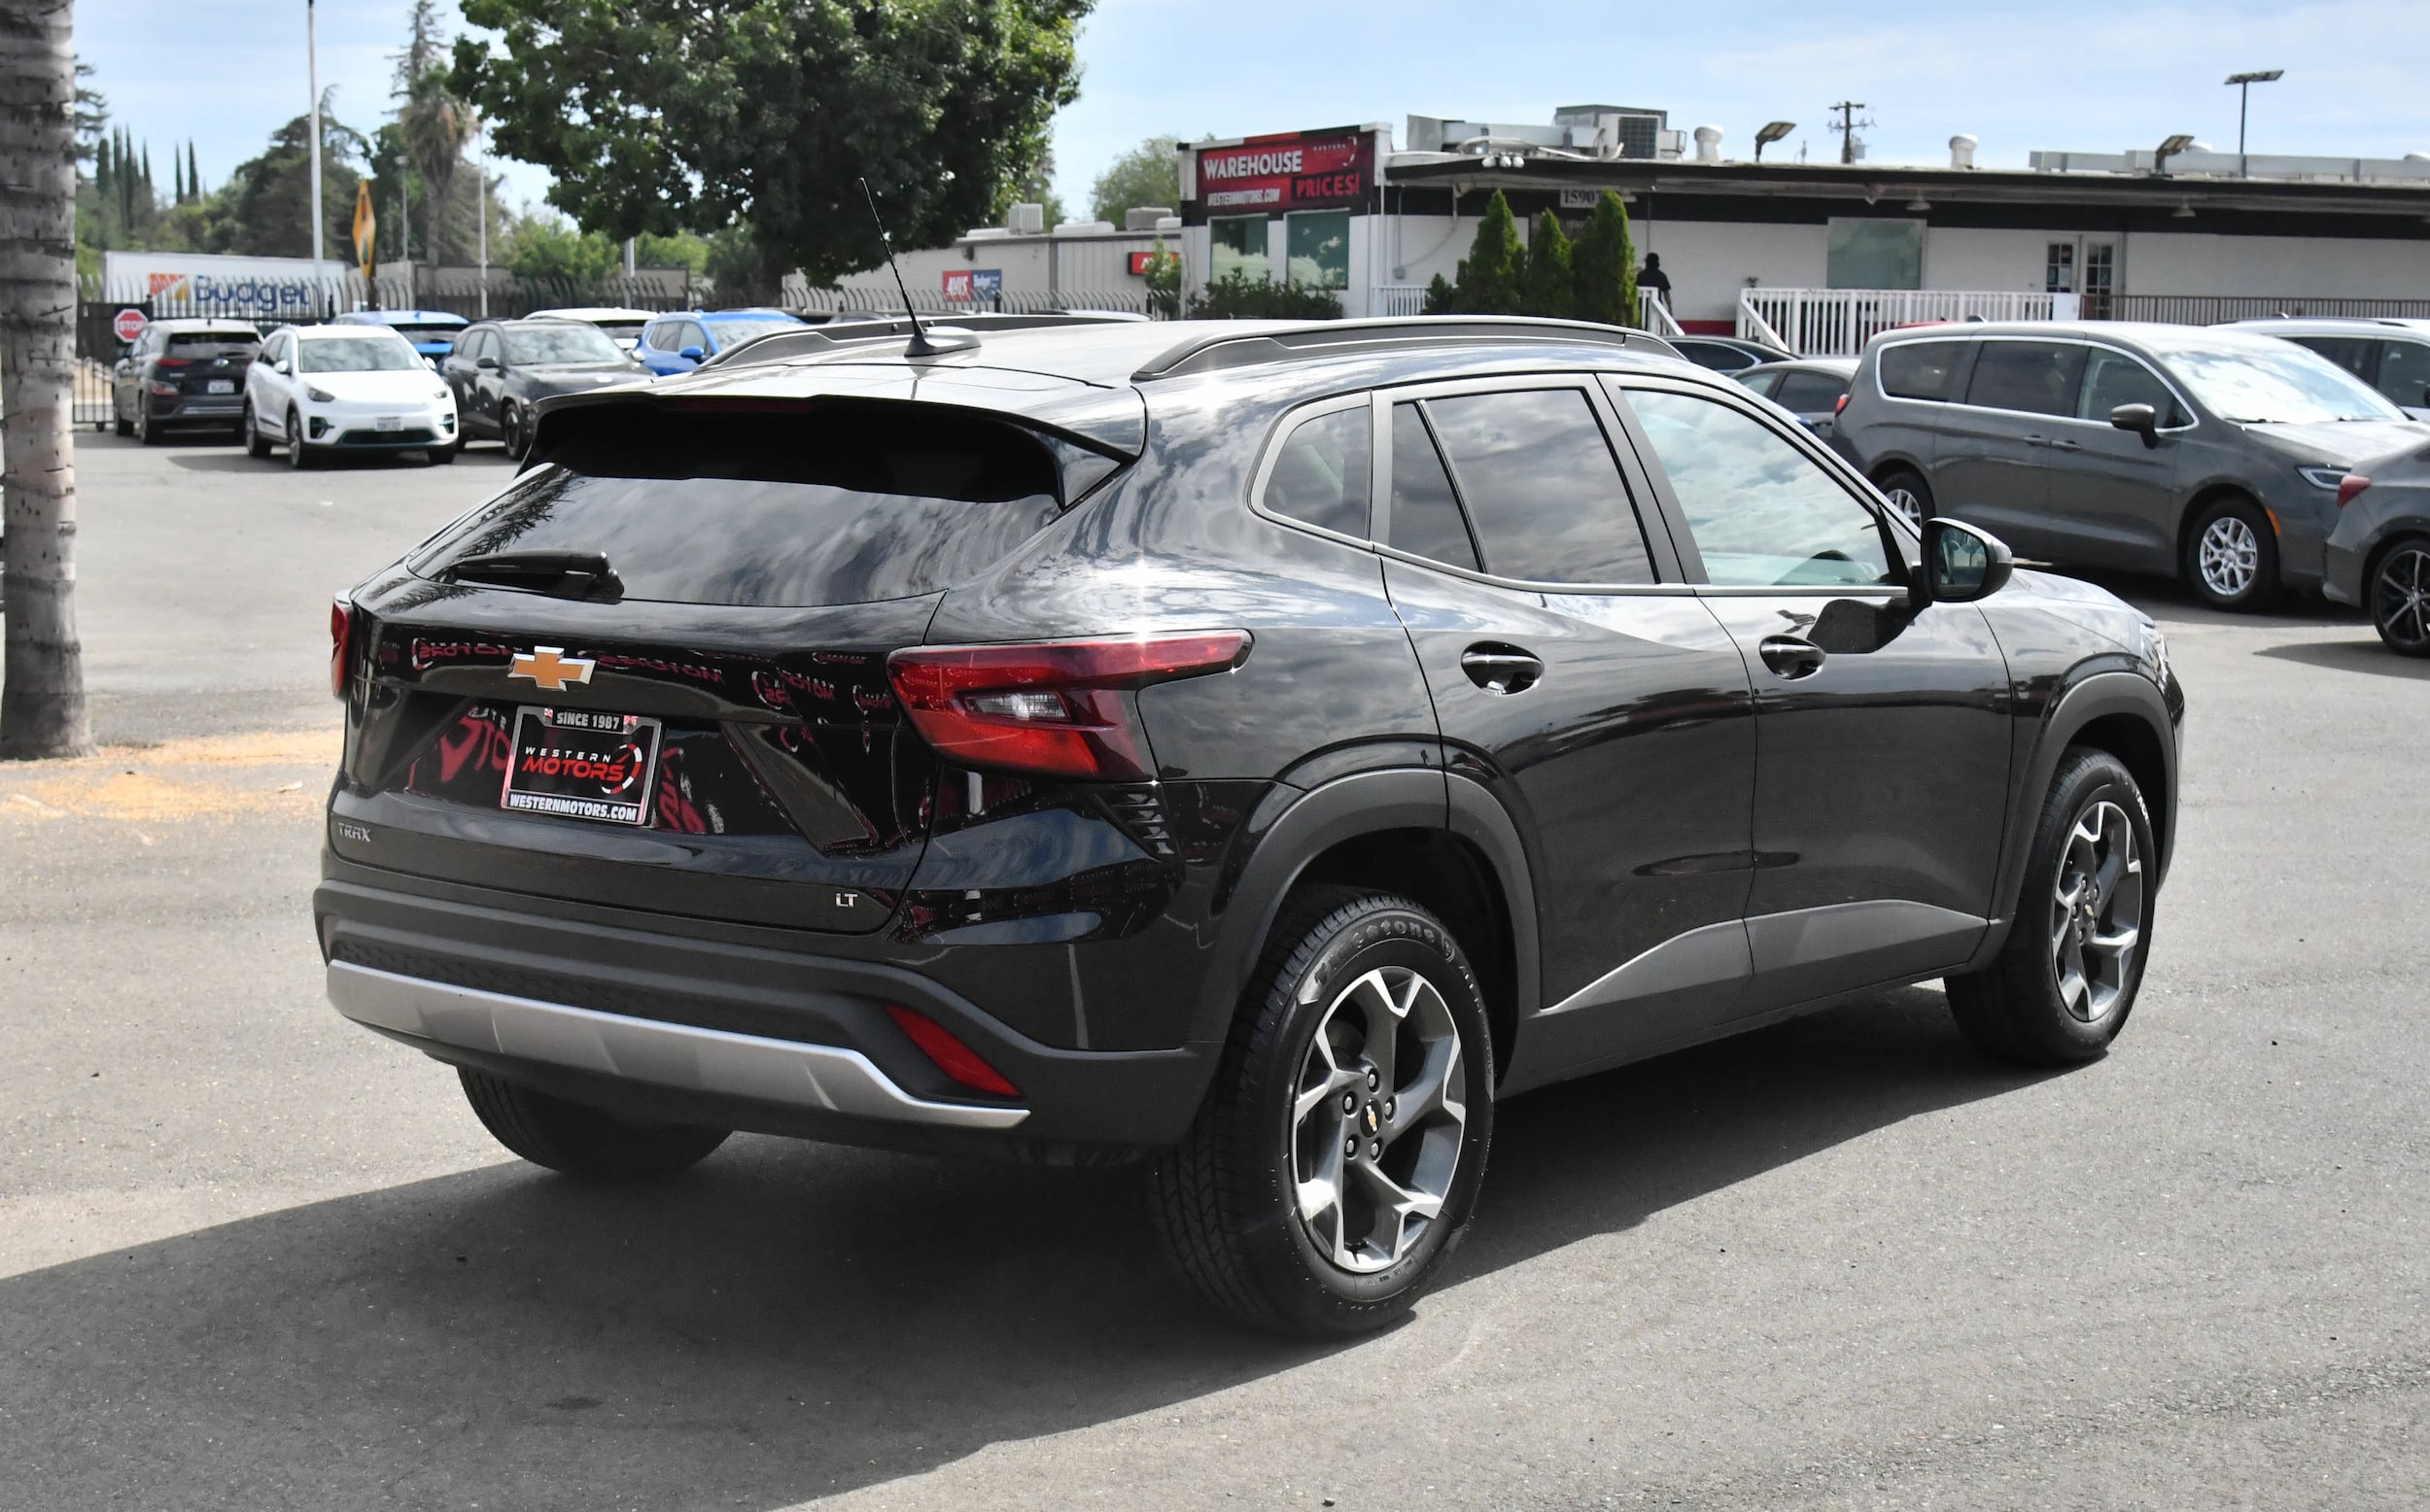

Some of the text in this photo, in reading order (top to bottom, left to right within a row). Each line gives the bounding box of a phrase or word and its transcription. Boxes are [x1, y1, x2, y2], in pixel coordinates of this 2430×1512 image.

[1203, 150, 1302, 180] WAREHOUSE
[1296, 173, 1360, 198] PRICES!
[196, 275, 310, 312] Budget
[948, 276, 969, 292] AVIS
[119, 320, 146, 332] STOP
[556, 711, 620, 730] SINCE 1987
[525, 746, 611, 763] WESTERN
[521, 756, 626, 782] MOTORS
[509, 793, 638, 822] WESTERNMOTORS.COM
[337, 822, 371, 842] TRAX
[835, 893, 858, 908] LT
